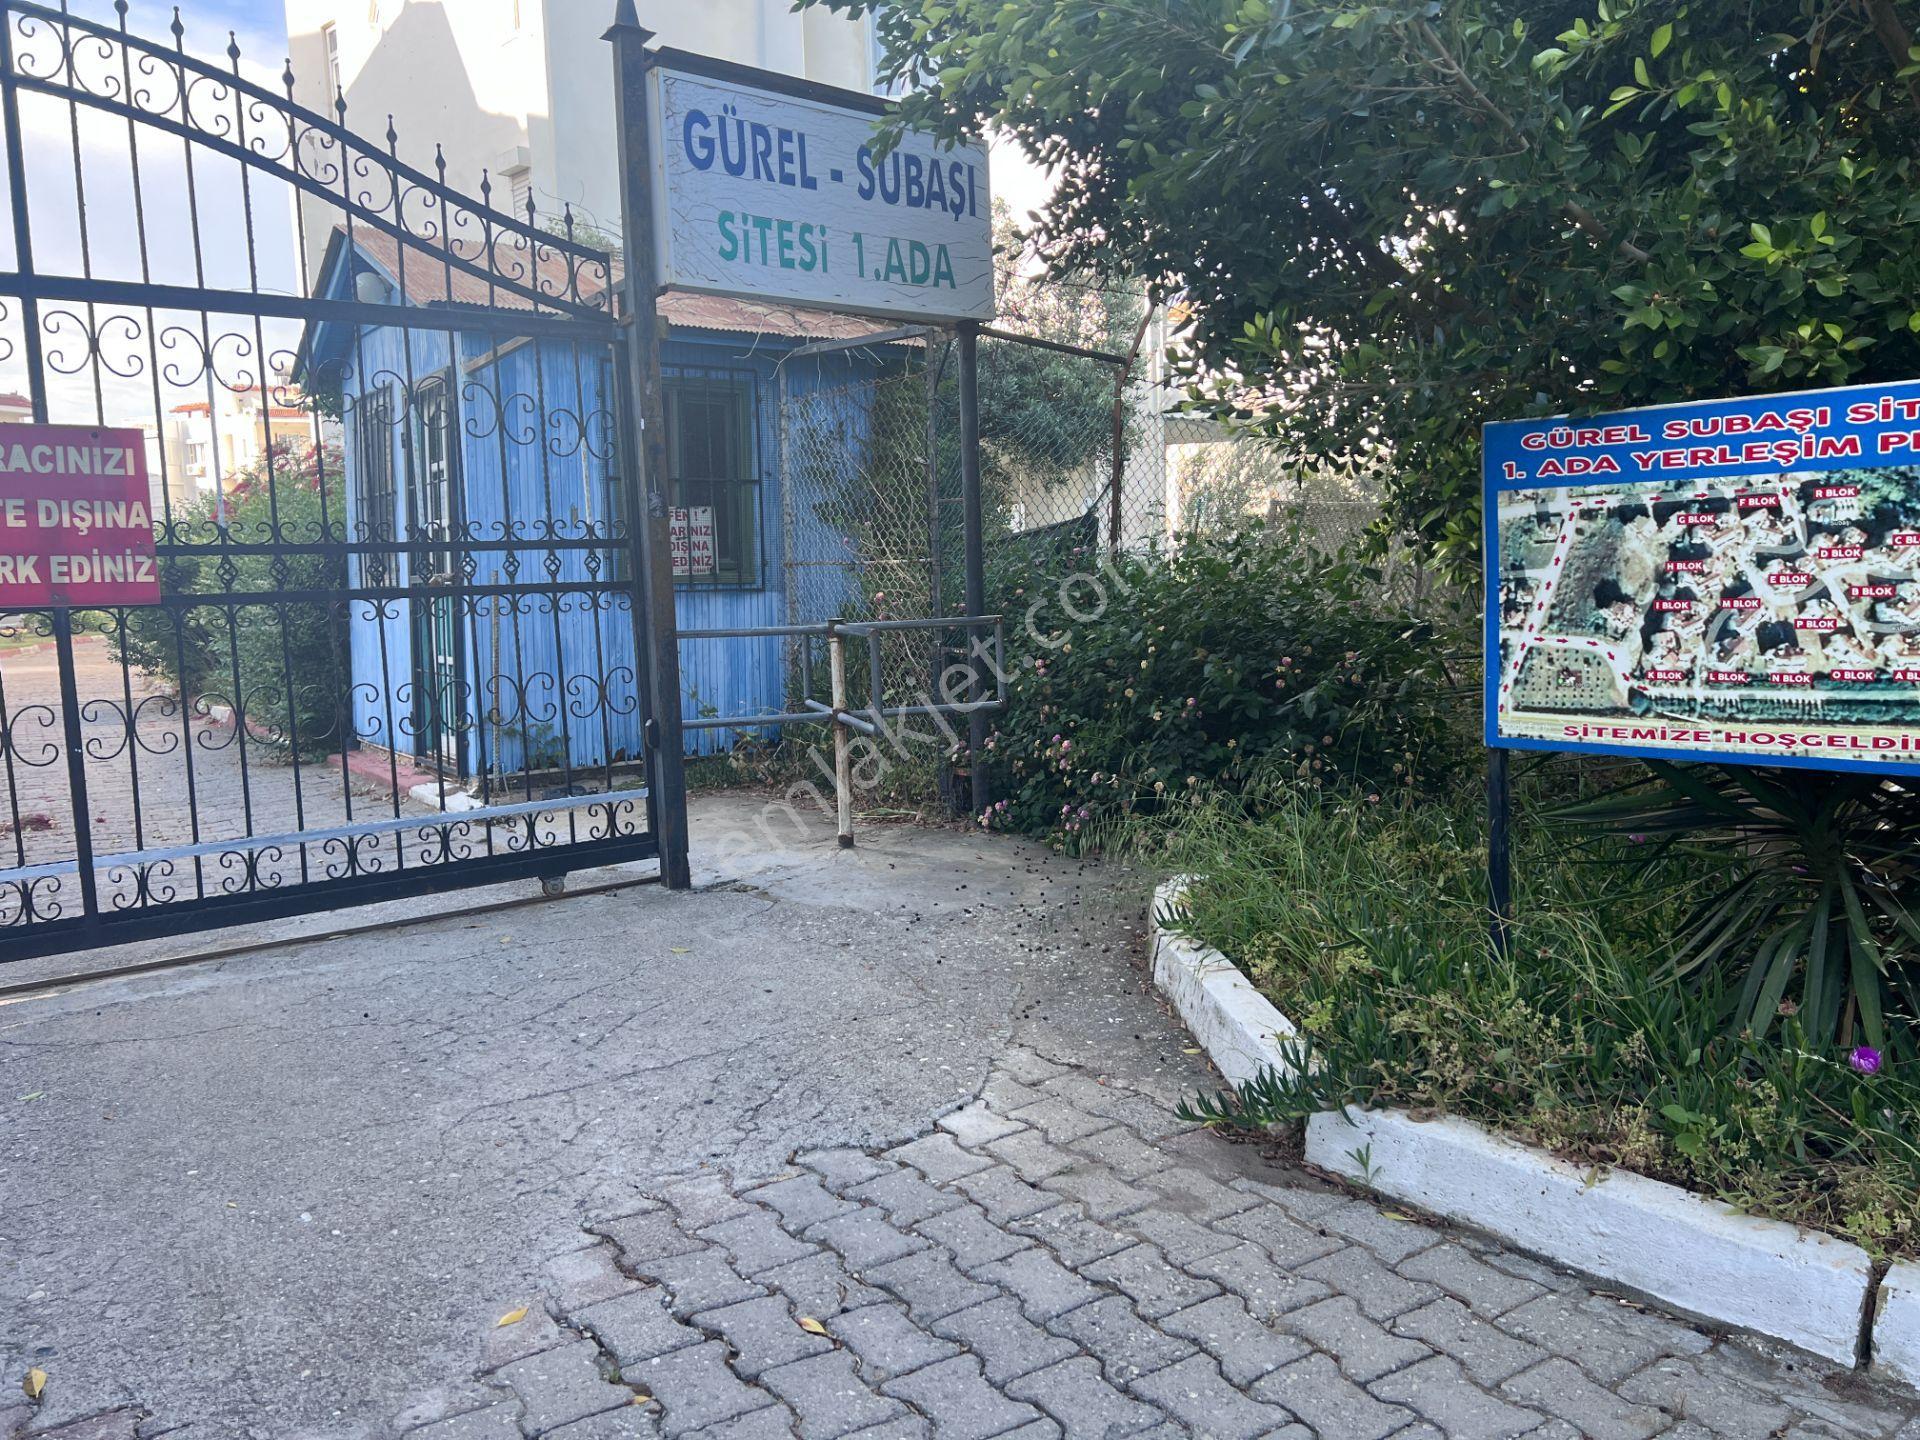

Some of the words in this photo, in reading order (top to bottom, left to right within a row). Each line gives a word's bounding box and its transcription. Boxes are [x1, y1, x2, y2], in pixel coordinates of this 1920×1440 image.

[683, 103, 817, 190] GÜREL
[857, 144, 976, 221] SUBAŞI
[852, 232, 956, 289] 1.ADA
[1521, 424, 1651, 450] GÜREL
[1662, 408, 1830, 434] SUBAŞI
[1502, 461, 1526, 480] 1.
[1536, 454, 1620, 478] ADA
[1632, 433, 1861, 466] YERLEŞİM
[1826, 488, 1856, 496] BLOK
[1748, 496, 1776, 505] BLOK
[37, 499, 150, 535] DIŞINA
[1688, 514, 1714, 523] BLOK
[1832, 548, 1861, 557] BLOK
[50, 548, 155, 584] EDİNİZ
[1676, 562, 1702, 570] BLOK
[1780, 575, 1808, 583] BLOK
[1862, 588, 1893, 596] BLOK
[1733, 600, 1759, 608] BLOK
[1806, 620, 1834, 628] BLOK
[1657, 672, 1682, 680] BLOK
[1844, 671, 1873, 680] BLOK
[1563, 723, 1711, 743] SİTEMİZE
[1725, 731, 1920, 752] HOŞGELDİ
